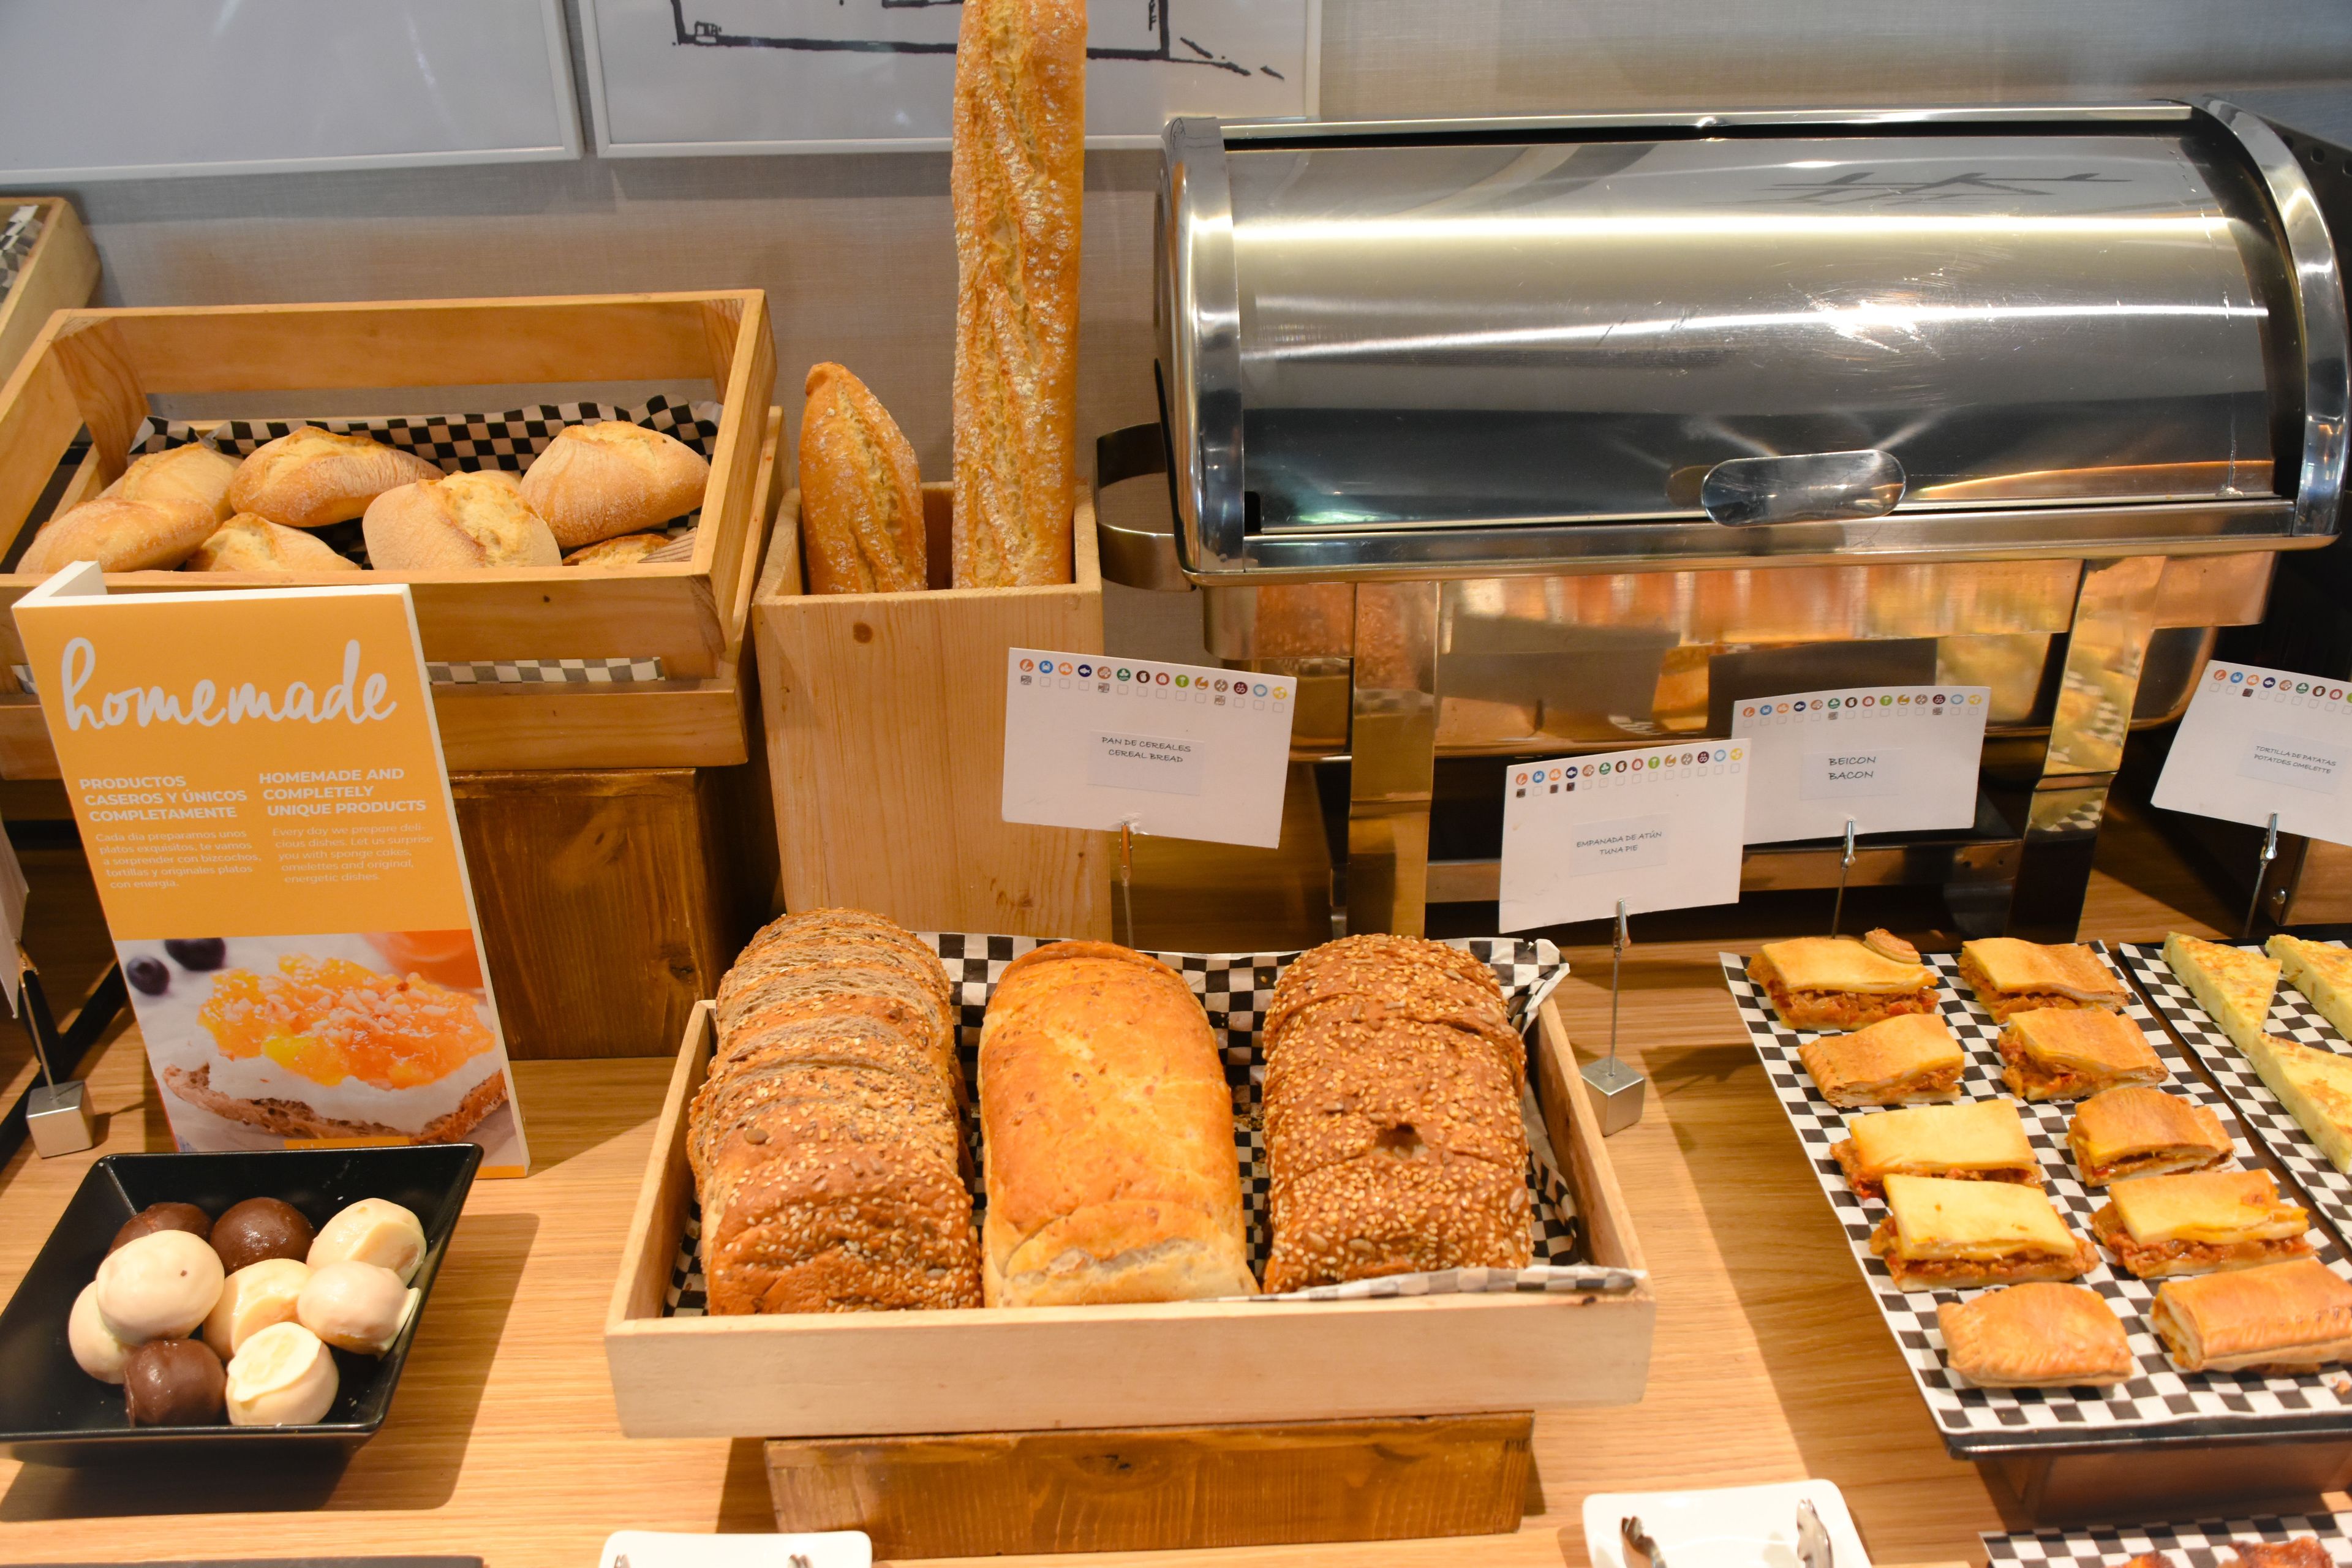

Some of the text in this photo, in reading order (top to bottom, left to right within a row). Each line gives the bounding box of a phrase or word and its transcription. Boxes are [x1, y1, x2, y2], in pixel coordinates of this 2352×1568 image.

[62, 637, 396, 731] homemade
[1139, 741, 1191, 752] CEREALES
[1109, 749, 1183, 762] CEREAL BREAD
[1828, 756, 1876, 766] BEICON
[2256, 745, 2290, 756] TORTILLA
[2303, 755, 2337, 766] PATATAS
[2254, 754, 2331, 774] POTATOES OMELETTE
[259, 768, 404, 783] HOMEMADE AND
[1828, 771, 1874, 780] BACON
[79, 776, 186, 790] PRODUCTOS
[84, 790, 247, 806] CASEROS Y ÚNICOS
[263, 785, 374, 800] COMPLETELY
[267, 799, 426, 816] UNIQUE PRODUCTS
[89, 807, 237, 822] COMPLETAMENTE
[96, 833, 125, 842] Cada
[148, 831, 216, 842] preparamos
[273, 828, 304, 837] Every
[307, 827, 328, 836] day
[352, 825, 397, 835] prepare
[400, 823, 424, 832] deli-
[275, 840, 306, 848] cious
[308, 838, 347, 847] dishes.
[351, 837, 368, 846] Let
[387, 835, 434, 845] surprise
[1577, 836, 1623, 847] EMPANADA
[1638, 830, 1662, 839] ATÚN
[99, 845, 134, 855] platos
[279, 852, 299, 861] you
[303, 850, 328, 859] with
[331, 849, 373, 859] sponge
[1599, 846, 1623, 855] TUNA
[113, 856, 174, 867] sorprender
[201, 853, 262, 862] bizcochos,
[281, 859, 413, 871] omelettes and original,
[106, 869, 149, 877] tortillas
[160, 866, 215, 876] originales
[217, 865, 253, 875] platos
[284, 872, 379, 884] energetic dishes.
